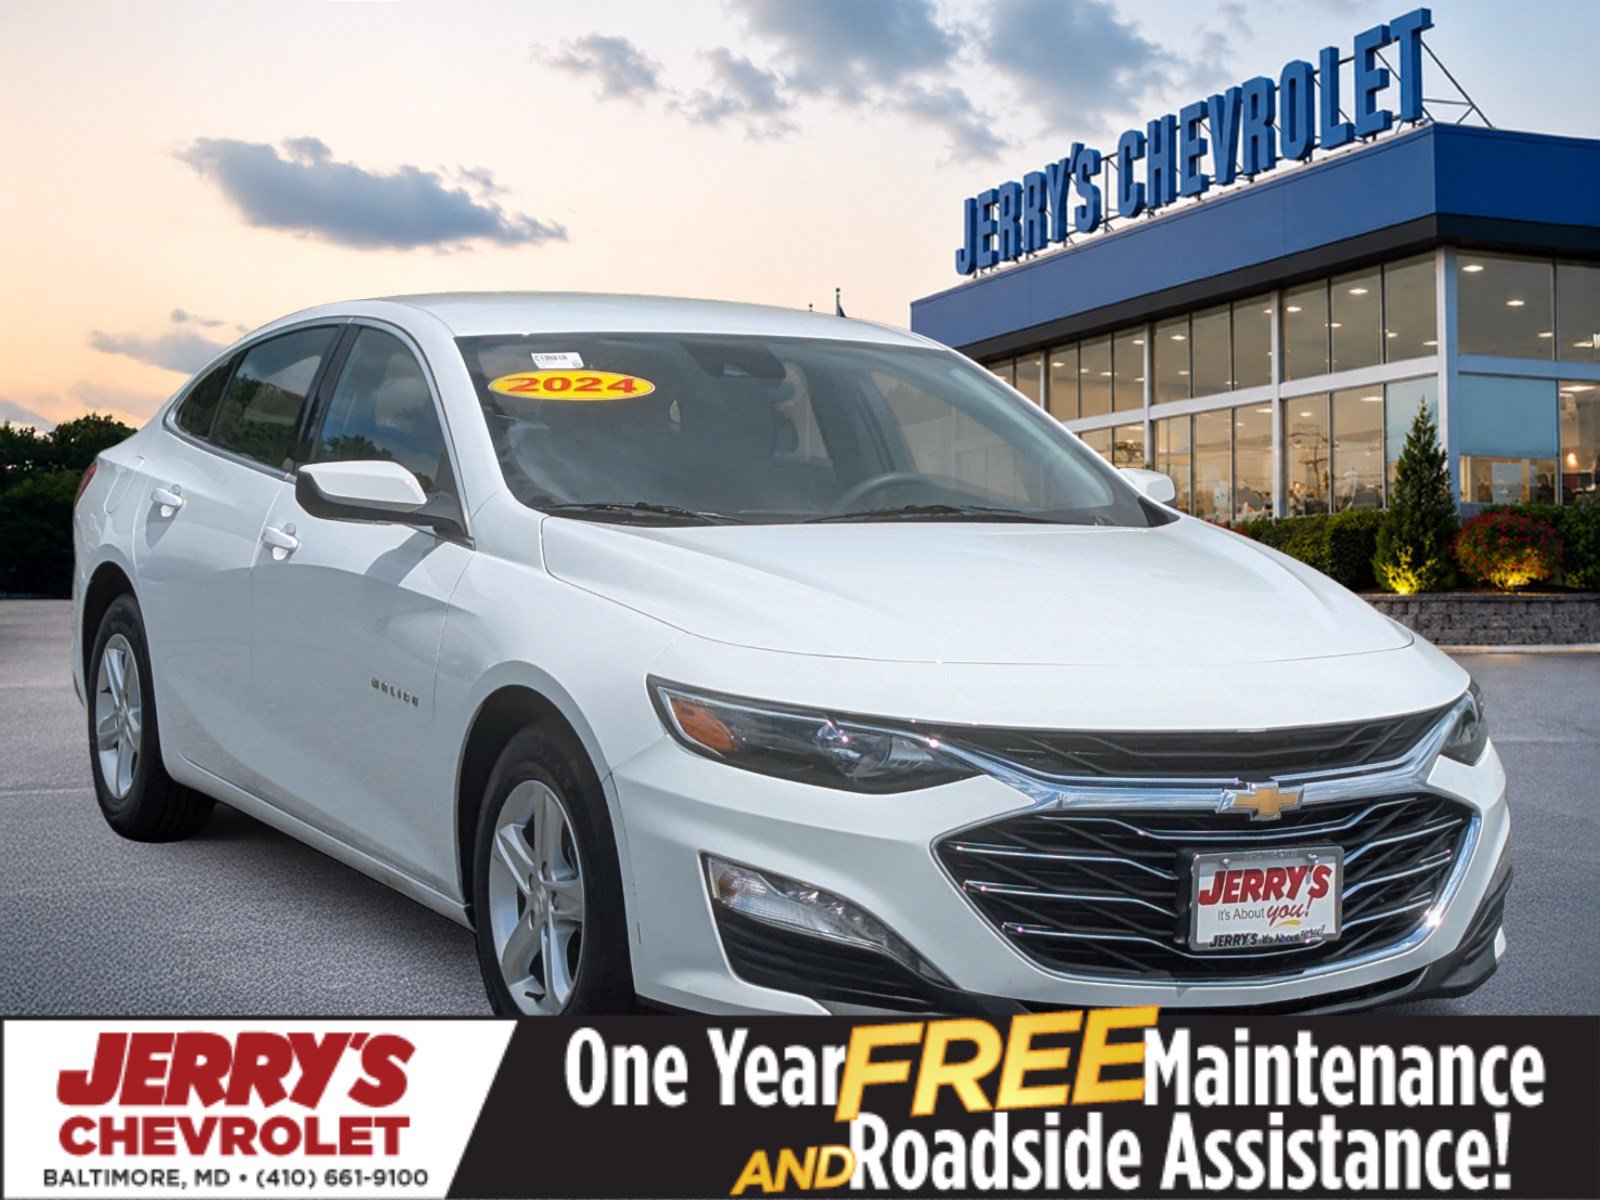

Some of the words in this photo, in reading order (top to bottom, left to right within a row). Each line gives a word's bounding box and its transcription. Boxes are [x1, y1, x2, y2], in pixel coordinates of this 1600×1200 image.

[956, 142, 1101, 275] JERRY'S
[1118, 8, 1434, 218] CHEVROLET
[505, 376, 637, 394] 2024
[1198, 864, 1332, 905] JERRY'S
[1218, 907, 1231, 921] It's
[1233, 906, 1265, 920] About
[1266, 896, 1313, 926] you!
[1209, 932, 1258, 948] JERRY'S
